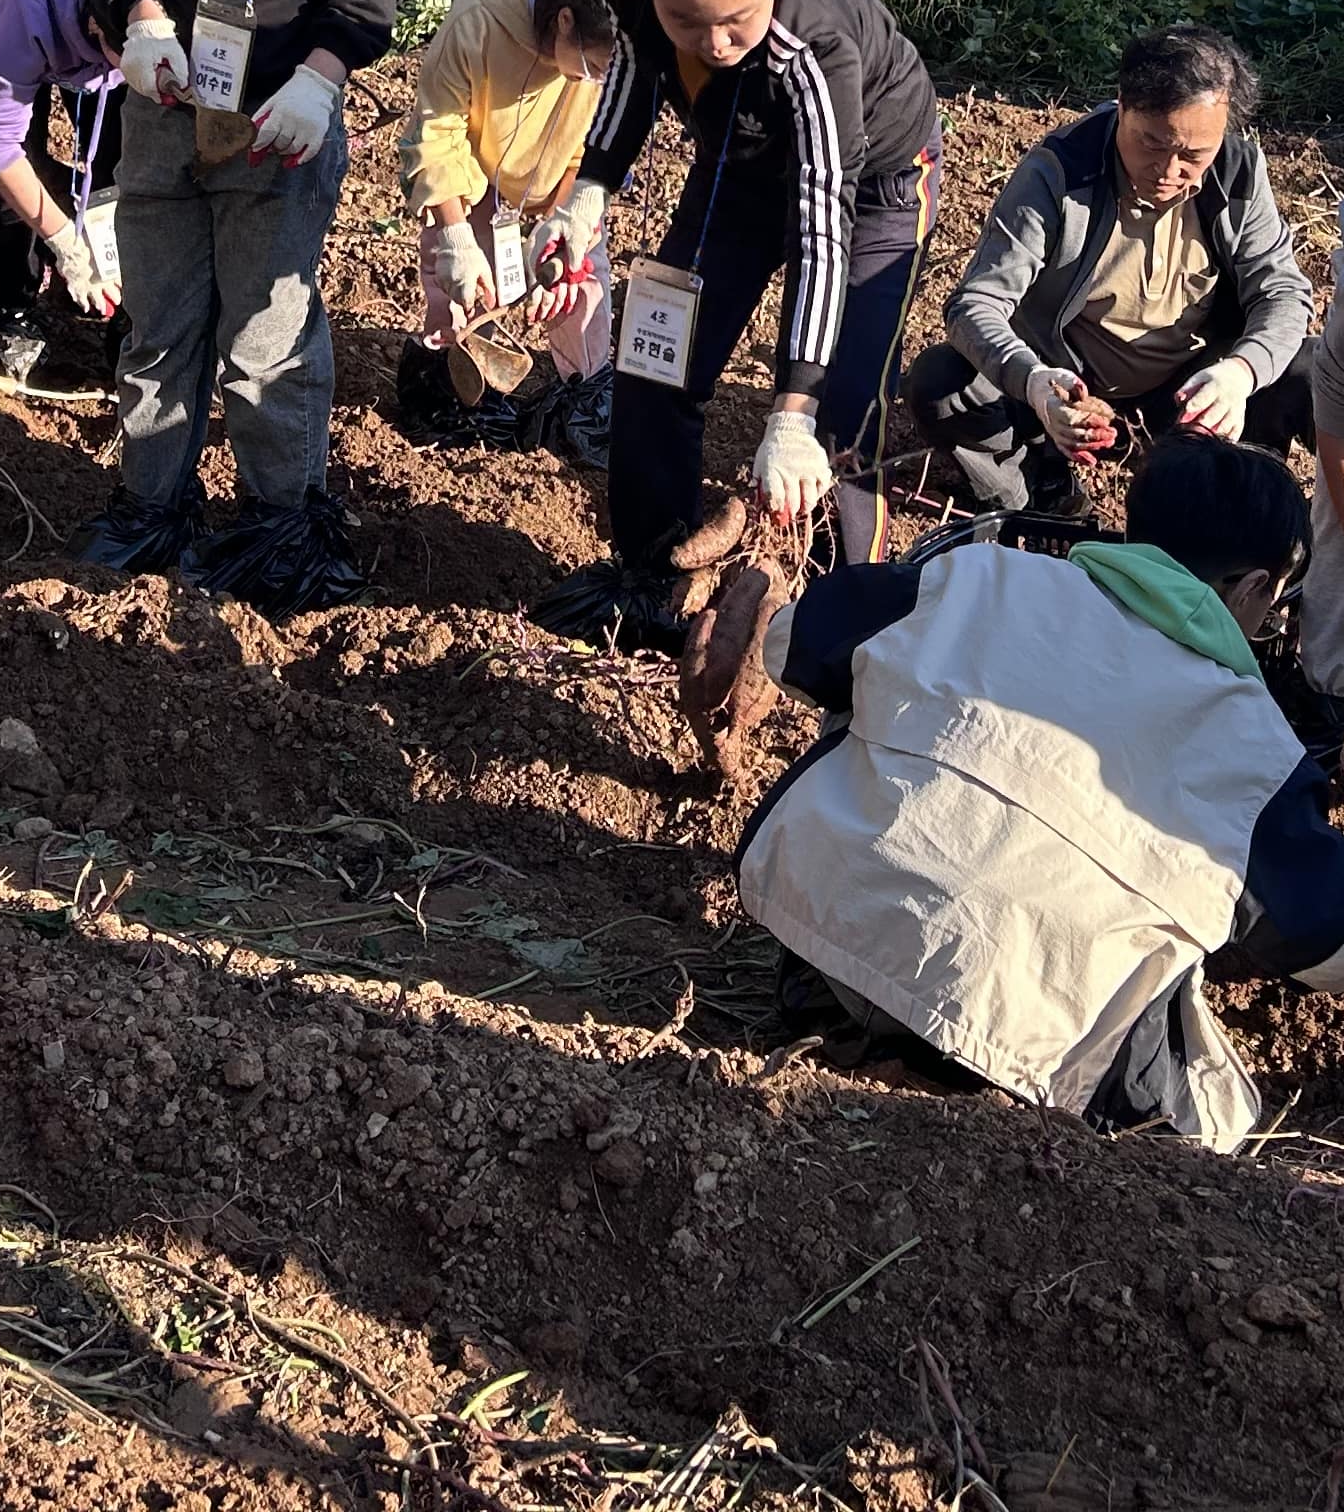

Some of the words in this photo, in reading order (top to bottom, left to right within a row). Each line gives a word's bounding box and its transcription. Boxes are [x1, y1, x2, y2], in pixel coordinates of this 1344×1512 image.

[211, 47, 227, 61] 4조
[196, 72, 233, 96] 이수빈
[649, 309, 669, 326] 4조
